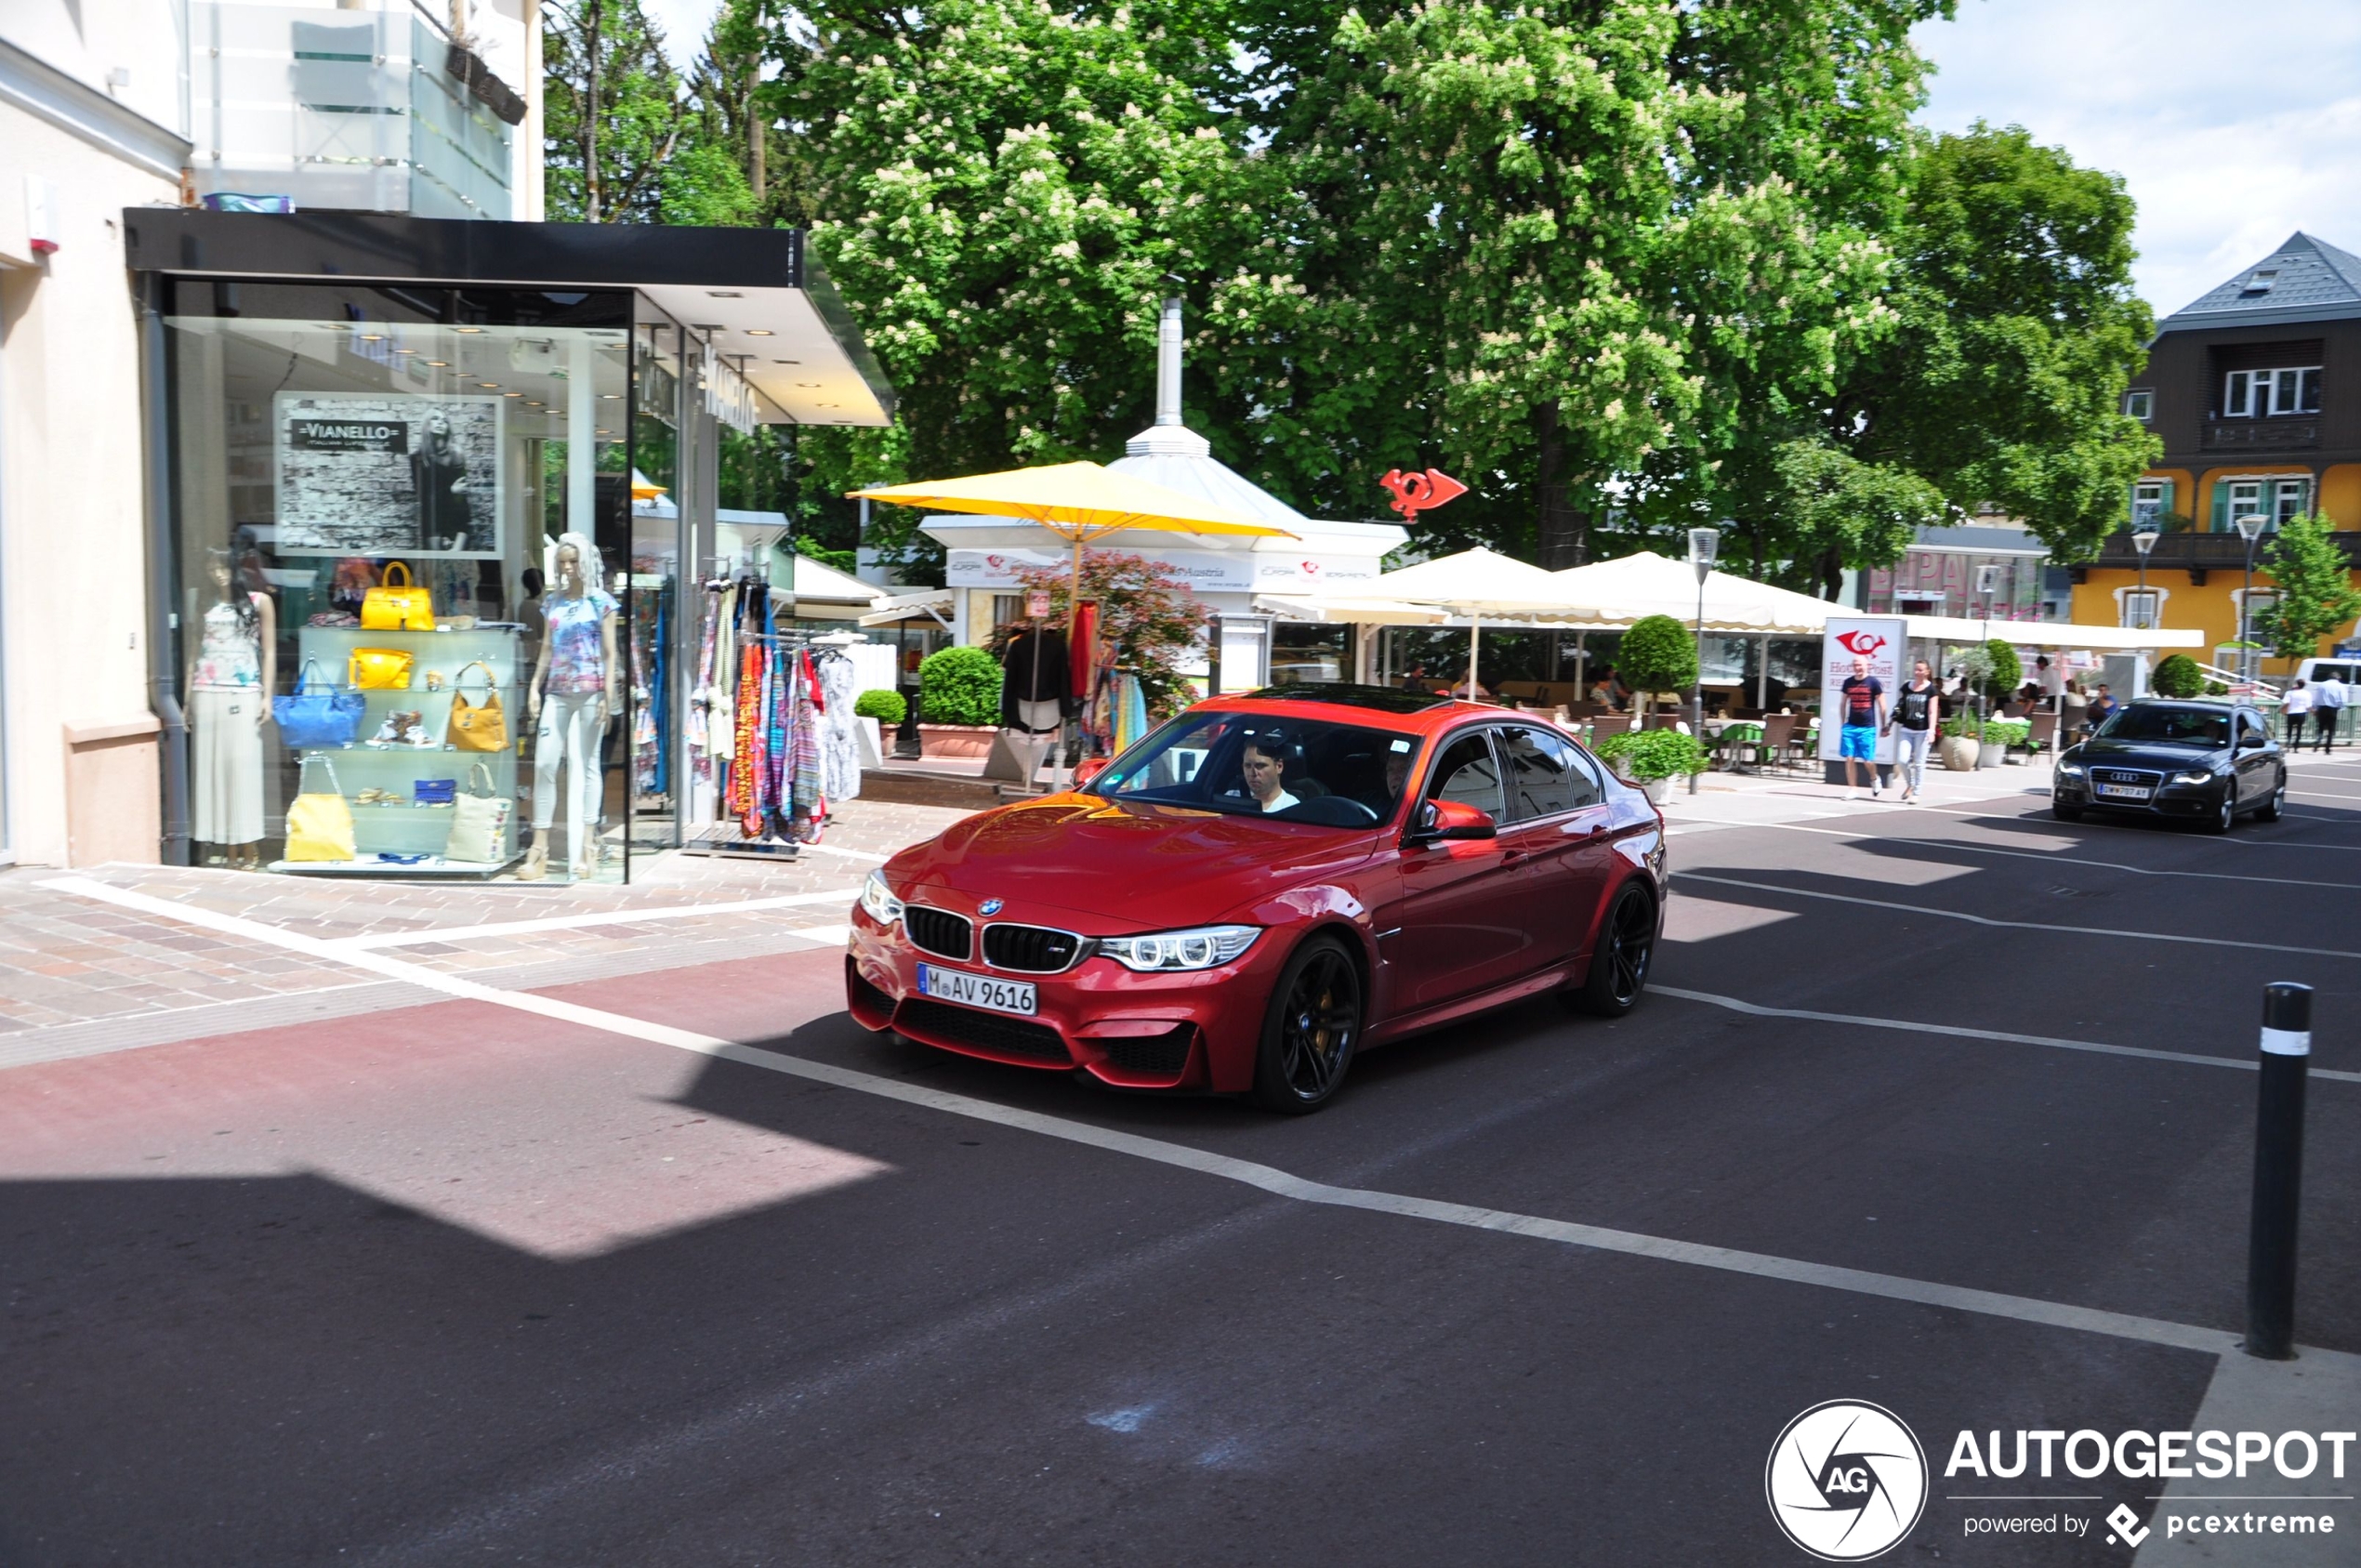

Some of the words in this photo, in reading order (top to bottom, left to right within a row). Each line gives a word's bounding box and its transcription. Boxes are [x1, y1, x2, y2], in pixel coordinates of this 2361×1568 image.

[306, 423, 390, 440] VIANELLO
[928, 969, 940, 994] M
[952, 976, 976, 1001] AV
[982, 982, 1032, 1011] 9616
